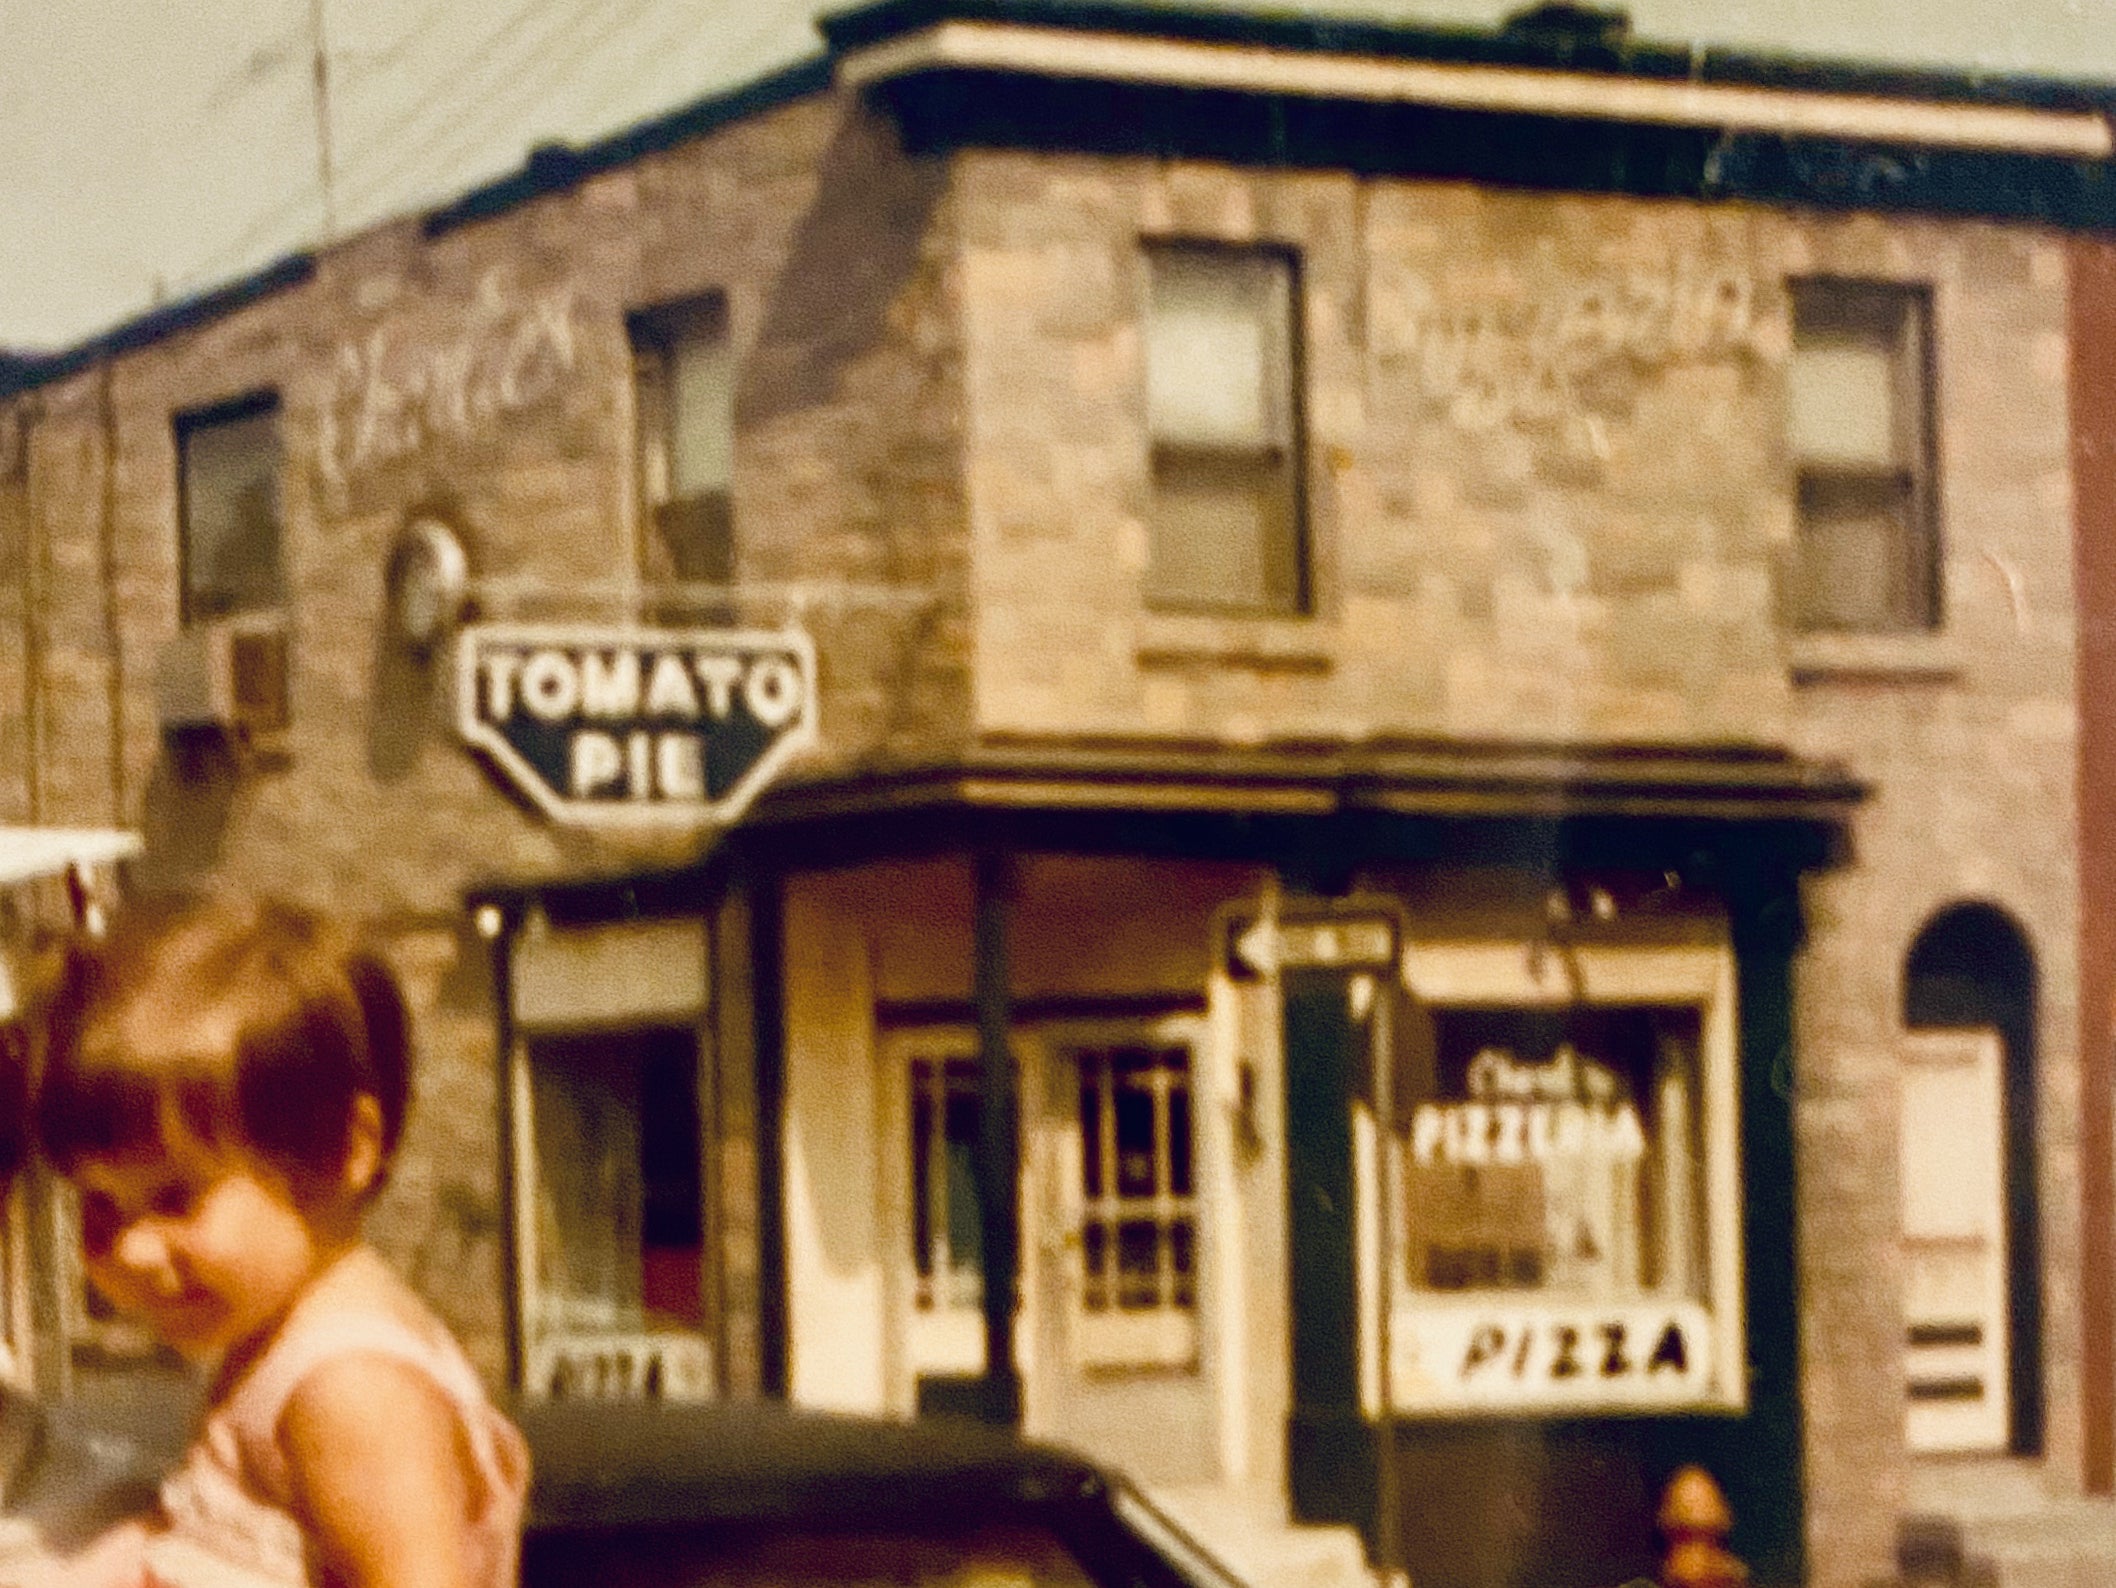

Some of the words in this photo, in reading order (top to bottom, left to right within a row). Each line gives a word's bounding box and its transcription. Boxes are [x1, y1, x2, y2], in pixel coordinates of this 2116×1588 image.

[484, 650, 801, 727] TOMATO
[571, 730, 702, 799] PIE
[1461, 1321, 1689, 1380] PIZZA
